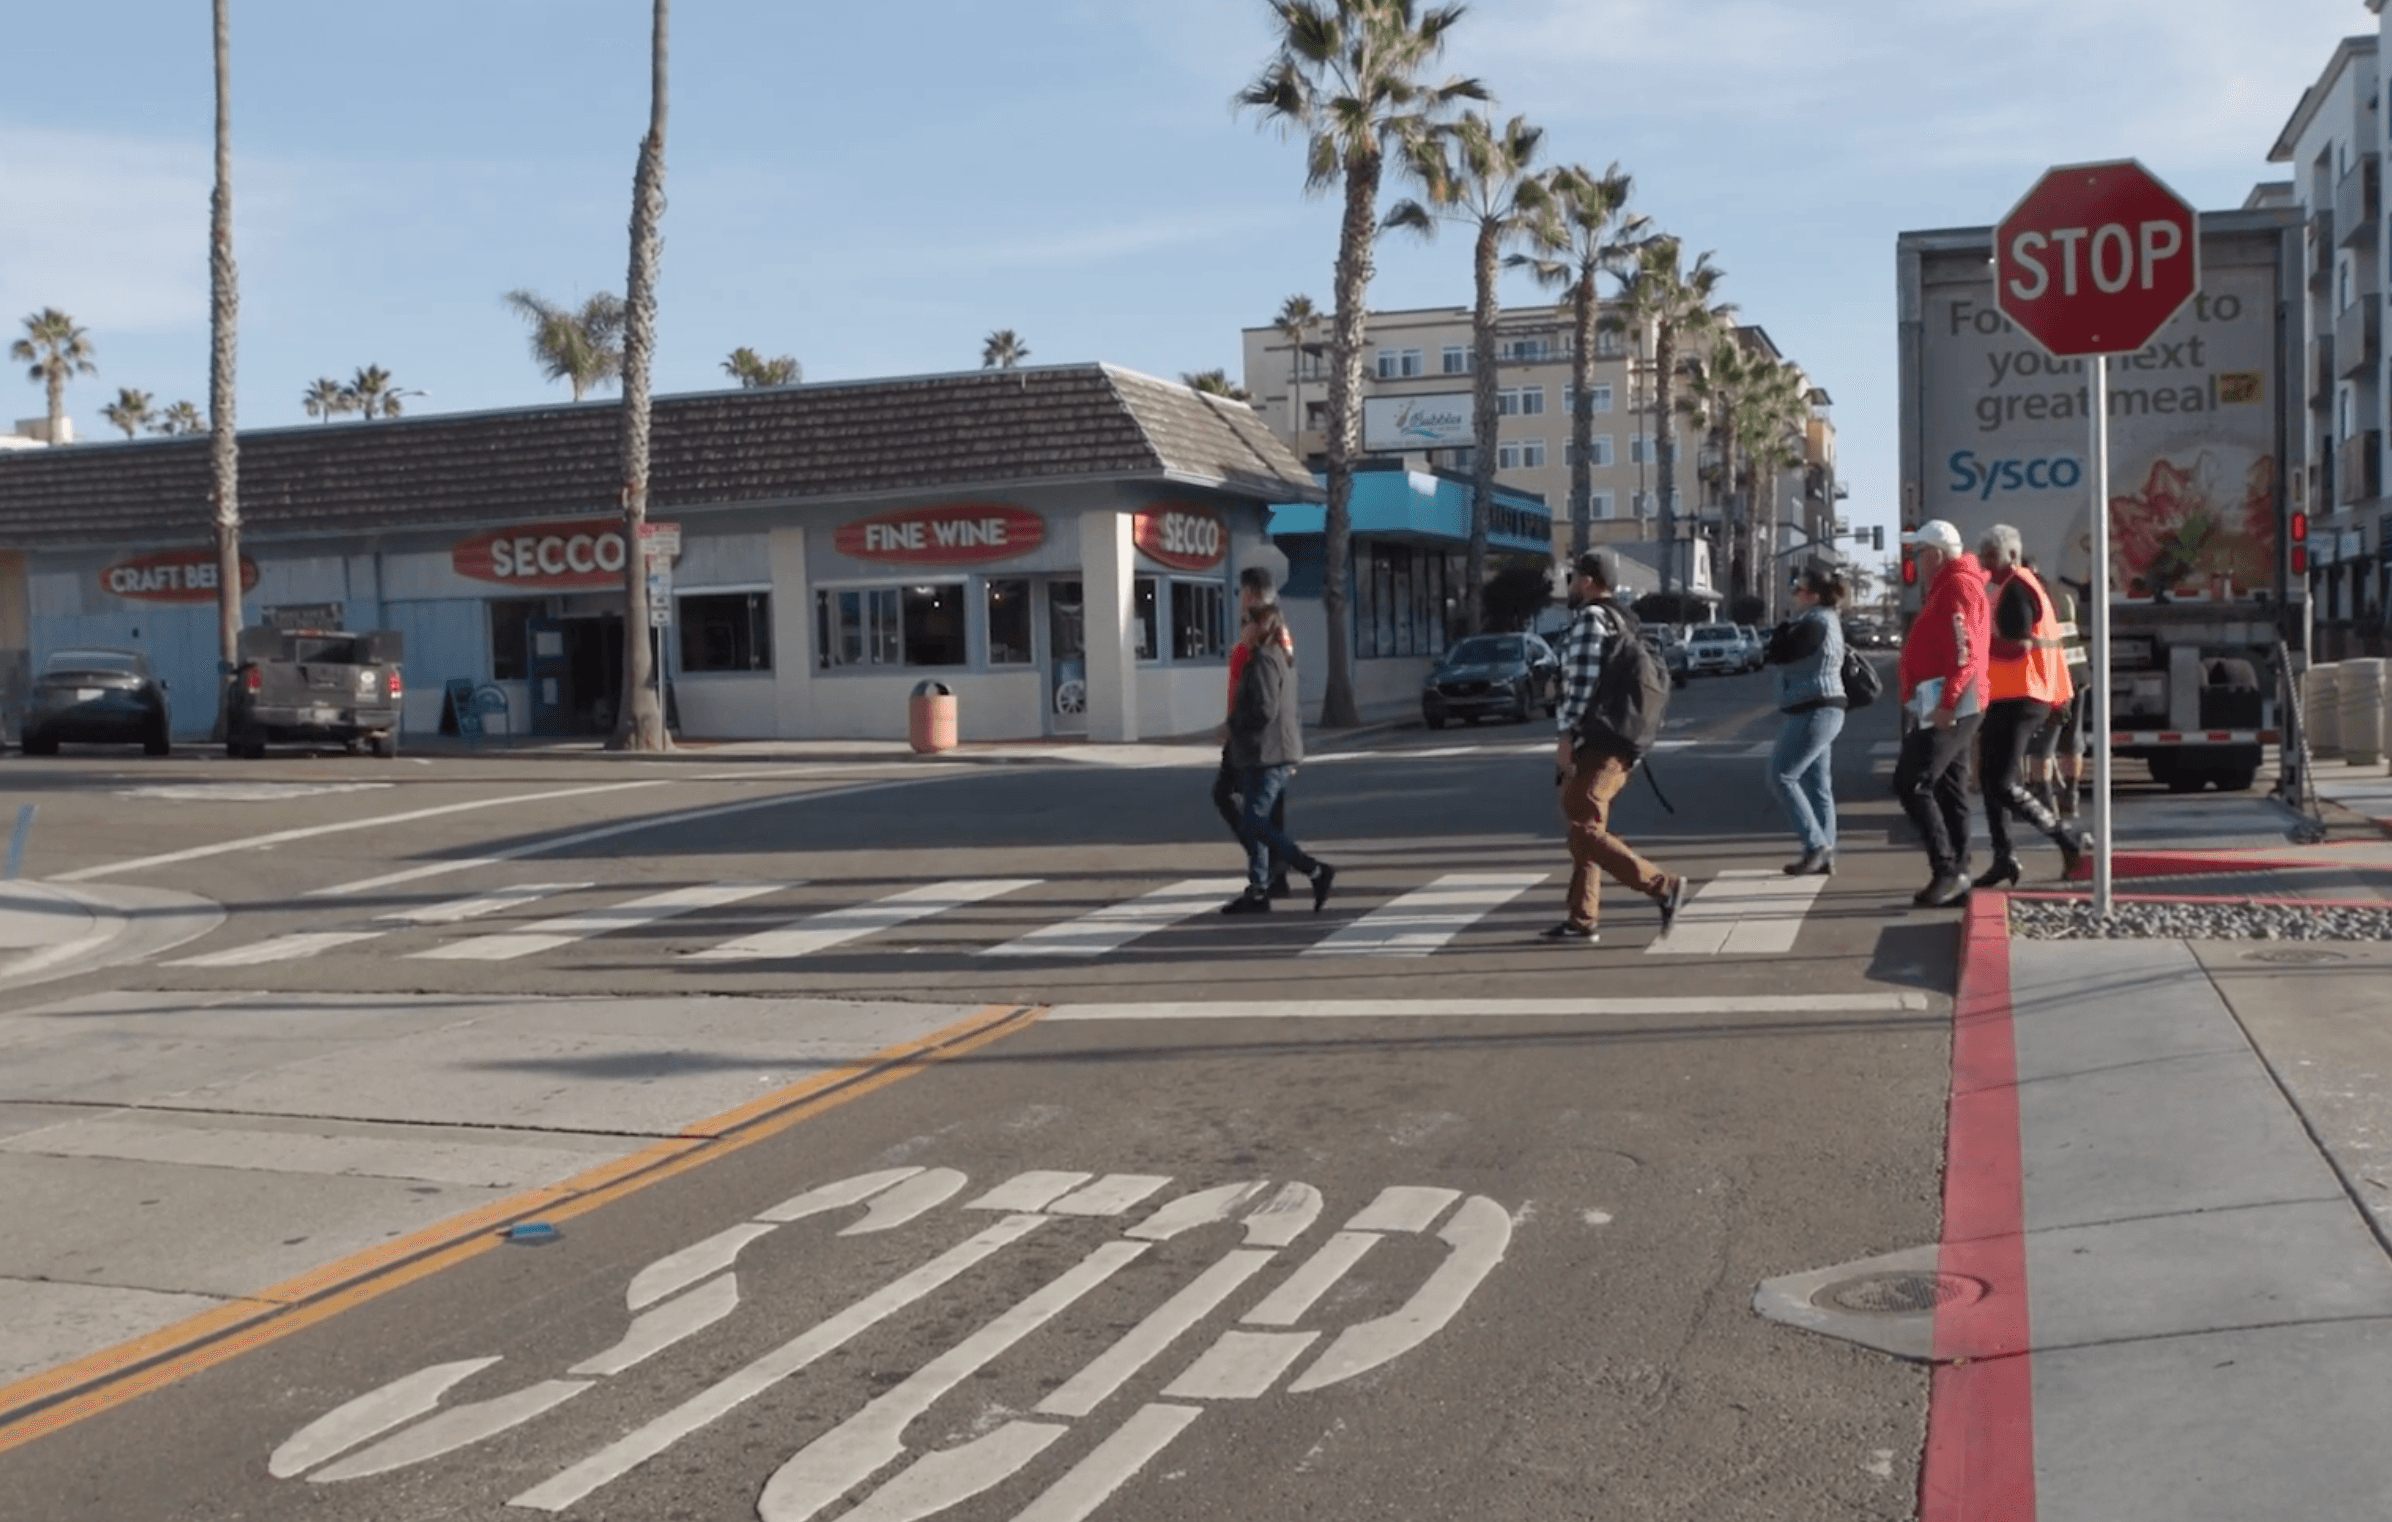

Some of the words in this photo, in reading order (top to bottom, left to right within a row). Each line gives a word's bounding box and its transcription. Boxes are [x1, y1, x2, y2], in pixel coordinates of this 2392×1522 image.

[2009, 219, 2183, 301] STOP
[2194, 293, 2241, 323] to
[2107, 335, 2206, 373] next
[1976, 386, 2089, 433] great
[2108, 374, 2218, 417] meal
[1950, 450, 2082, 501] Sysco
[491, 532, 626, 577] SECCO
[865, 521, 927, 551] FINE
[931, 517, 1008, 547] WINE
[1165, 511, 1219, 556] SECCO
[109, 566, 180, 592] CRAFT
[183, 563, 218, 588] BEE
[267, 1164, 1513, 1522] STOP
